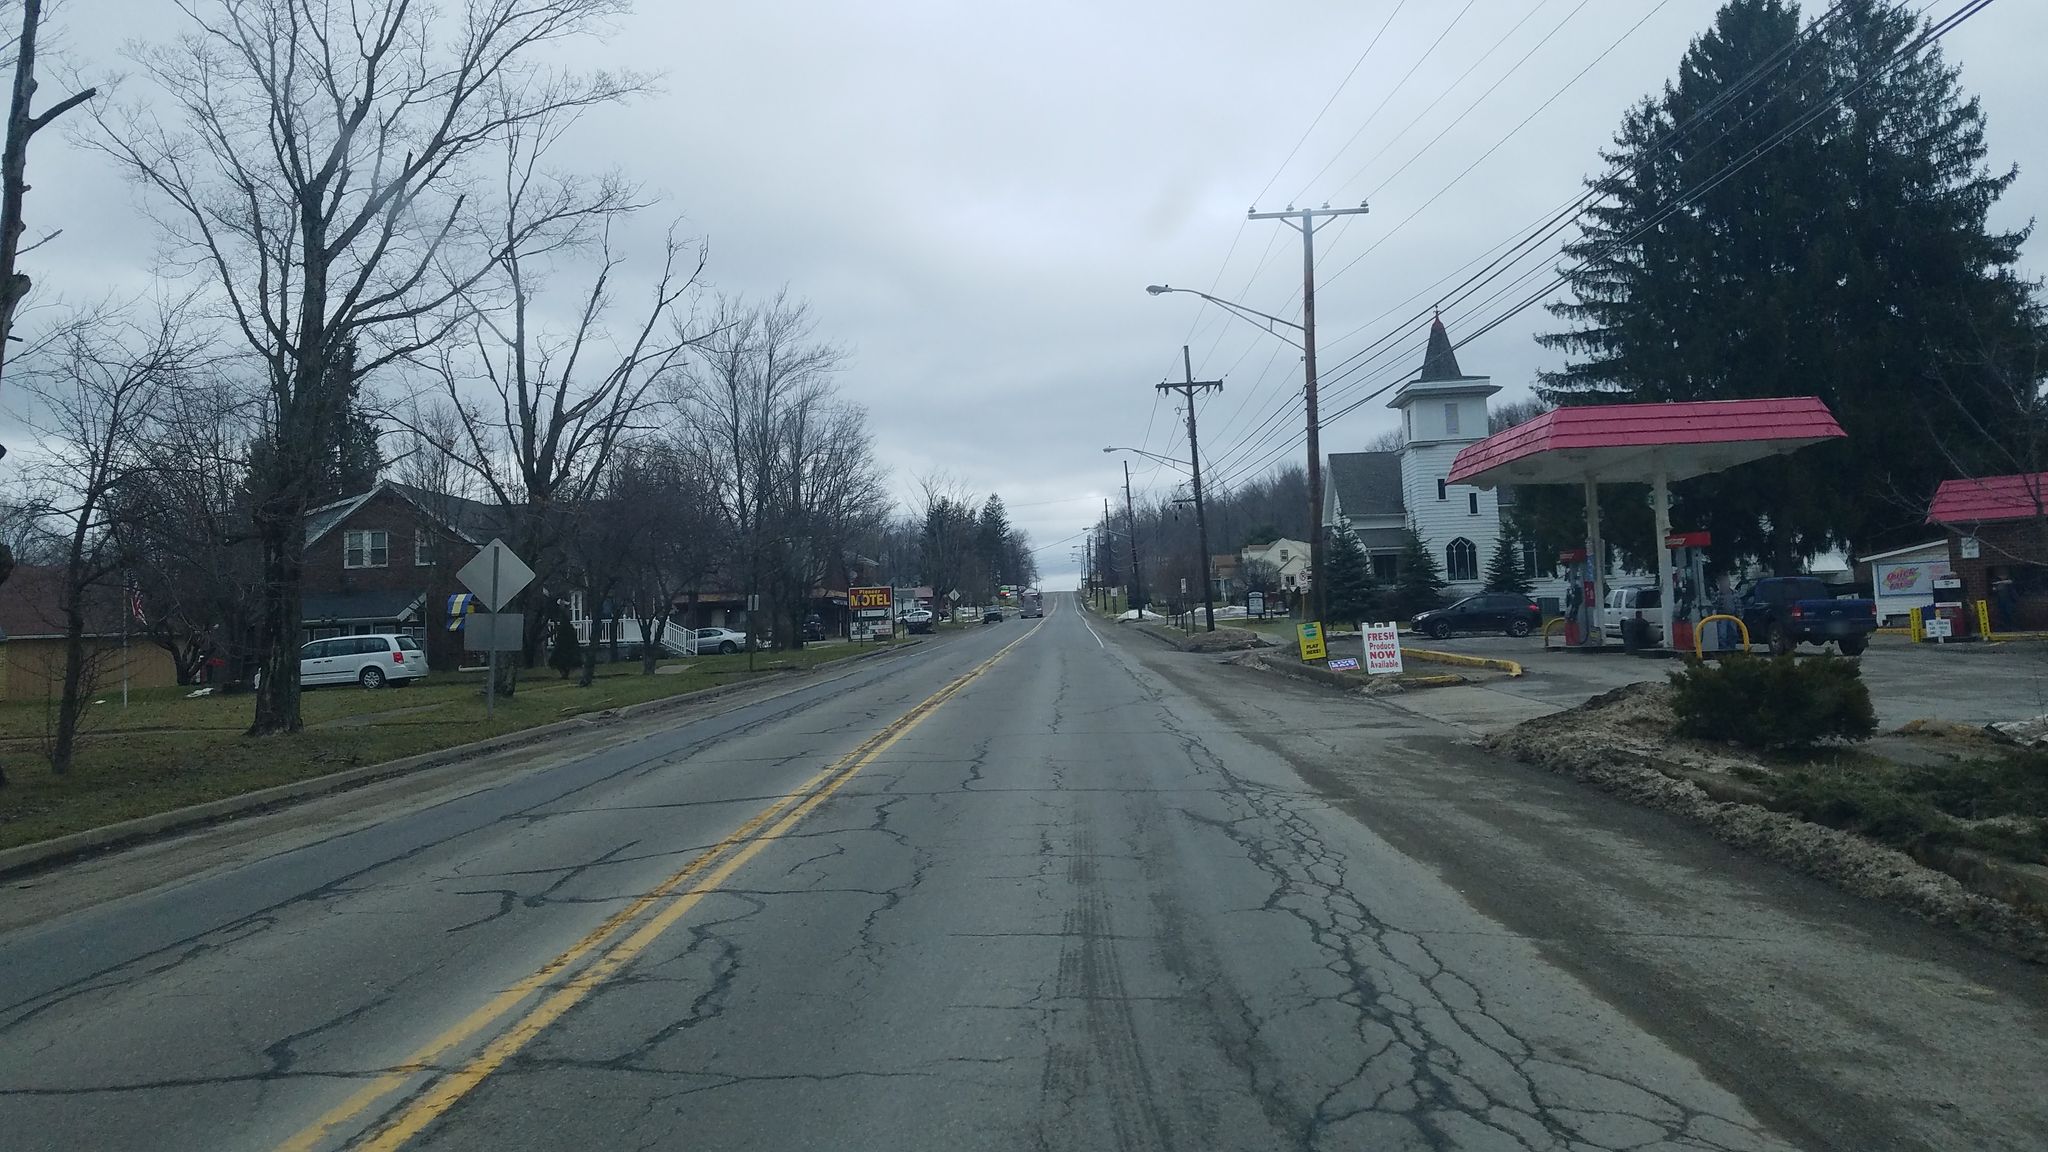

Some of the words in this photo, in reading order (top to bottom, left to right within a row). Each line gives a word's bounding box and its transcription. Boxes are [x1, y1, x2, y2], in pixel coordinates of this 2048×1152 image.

[851, 594, 890, 606] MOTEL
[1368, 632, 1395, 641] FRESH
[1370, 651, 1396, 659] NOW
[1370, 660, 1399, 669] Available
